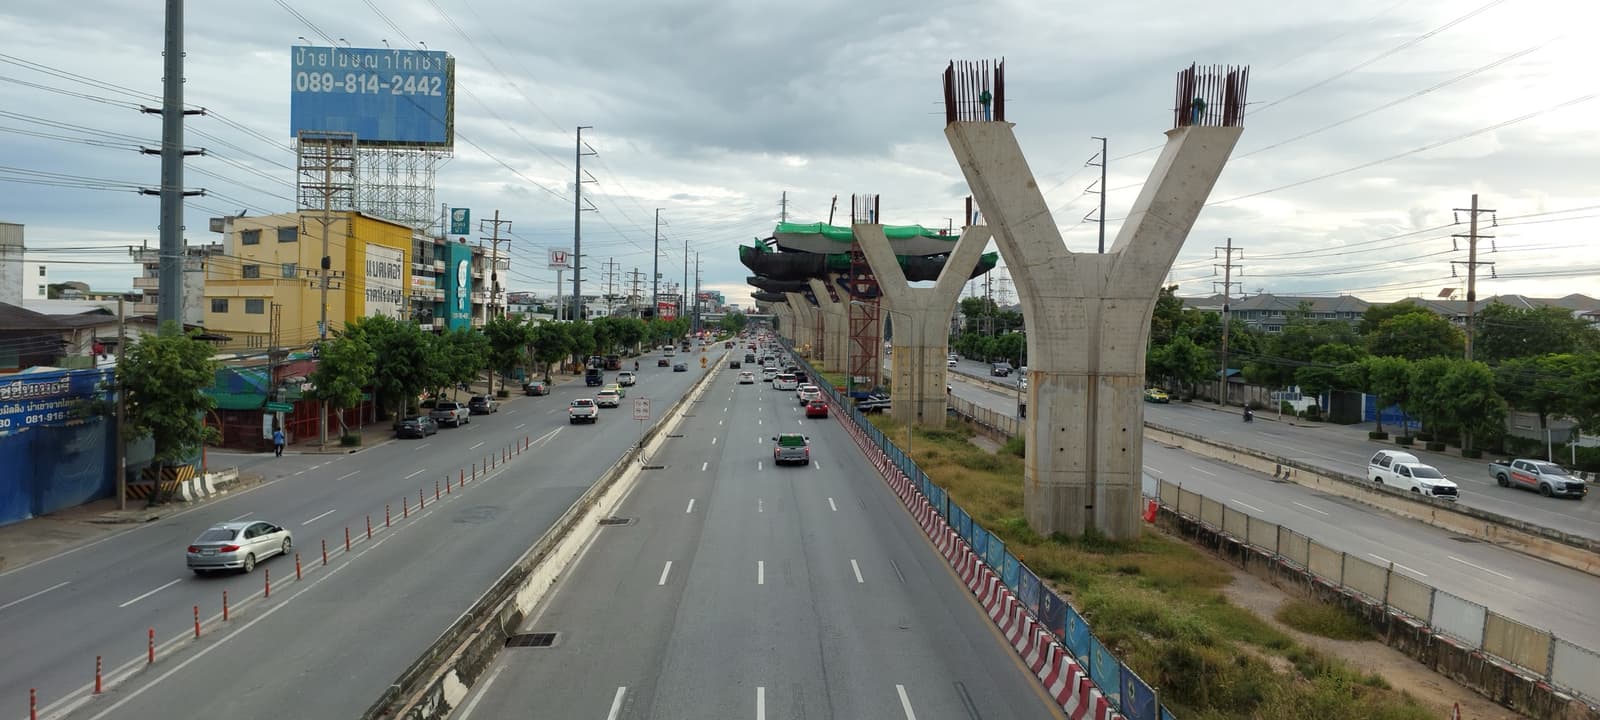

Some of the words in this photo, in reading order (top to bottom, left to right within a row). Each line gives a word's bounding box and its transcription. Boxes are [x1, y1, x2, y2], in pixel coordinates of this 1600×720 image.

[296, 47, 442, 71] ป้ายโฆษณาให้เช่า
[296, 71, 442, 96] 089-814-2442
